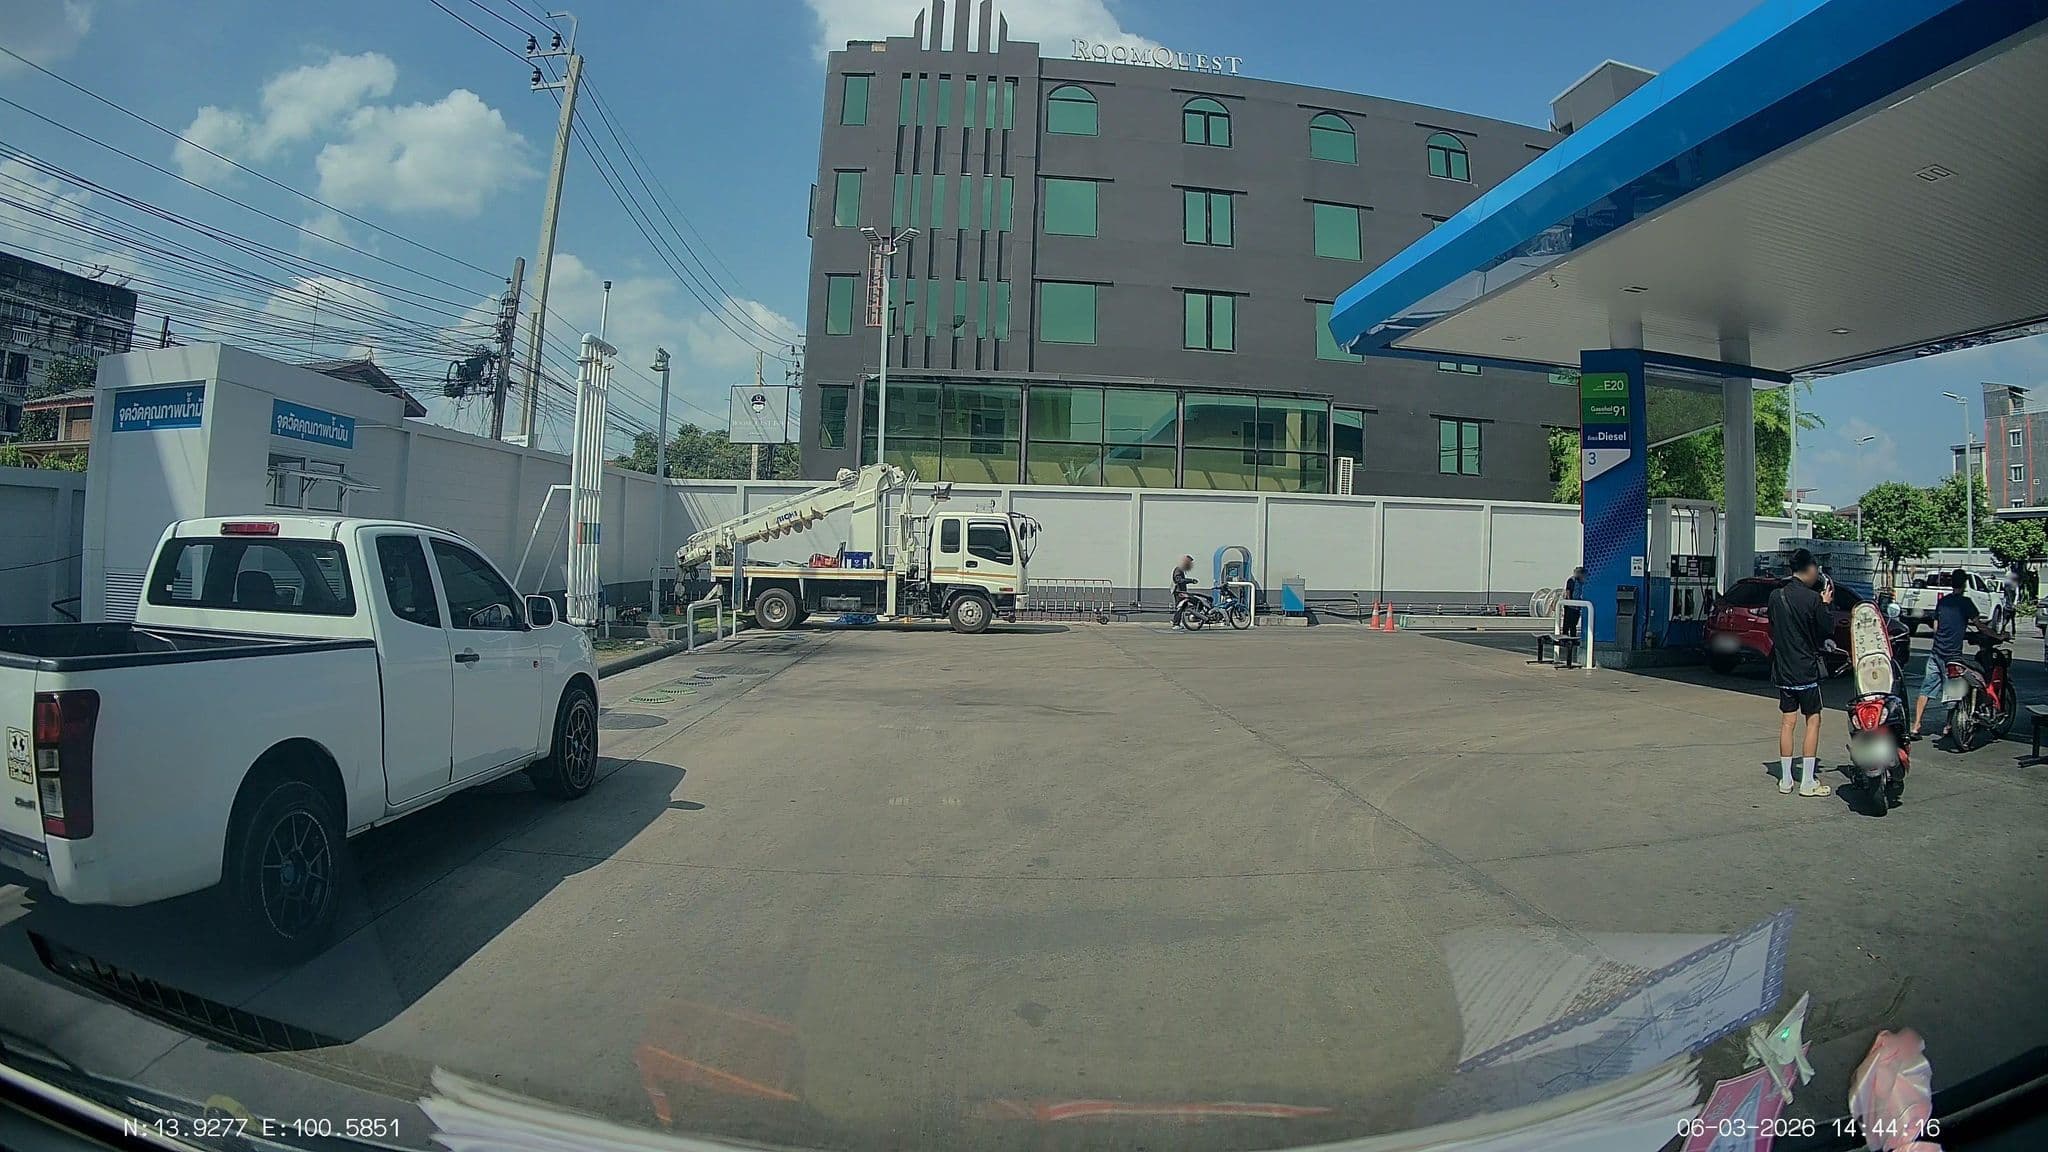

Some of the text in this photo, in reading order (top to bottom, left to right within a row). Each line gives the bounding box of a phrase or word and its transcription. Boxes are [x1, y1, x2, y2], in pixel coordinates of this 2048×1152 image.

[1604, 380, 1624, 391] E20
[119, 391, 204, 428] จุดวัดคุณภาพน้ำมั
[1613, 405, 1625, 417] 91
[277, 412, 349, 442] จุดวัดคุณภาพน้ำมัน
[1598, 431, 1627, 441] Diesel
[1588, 451, 1597, 465] 3
